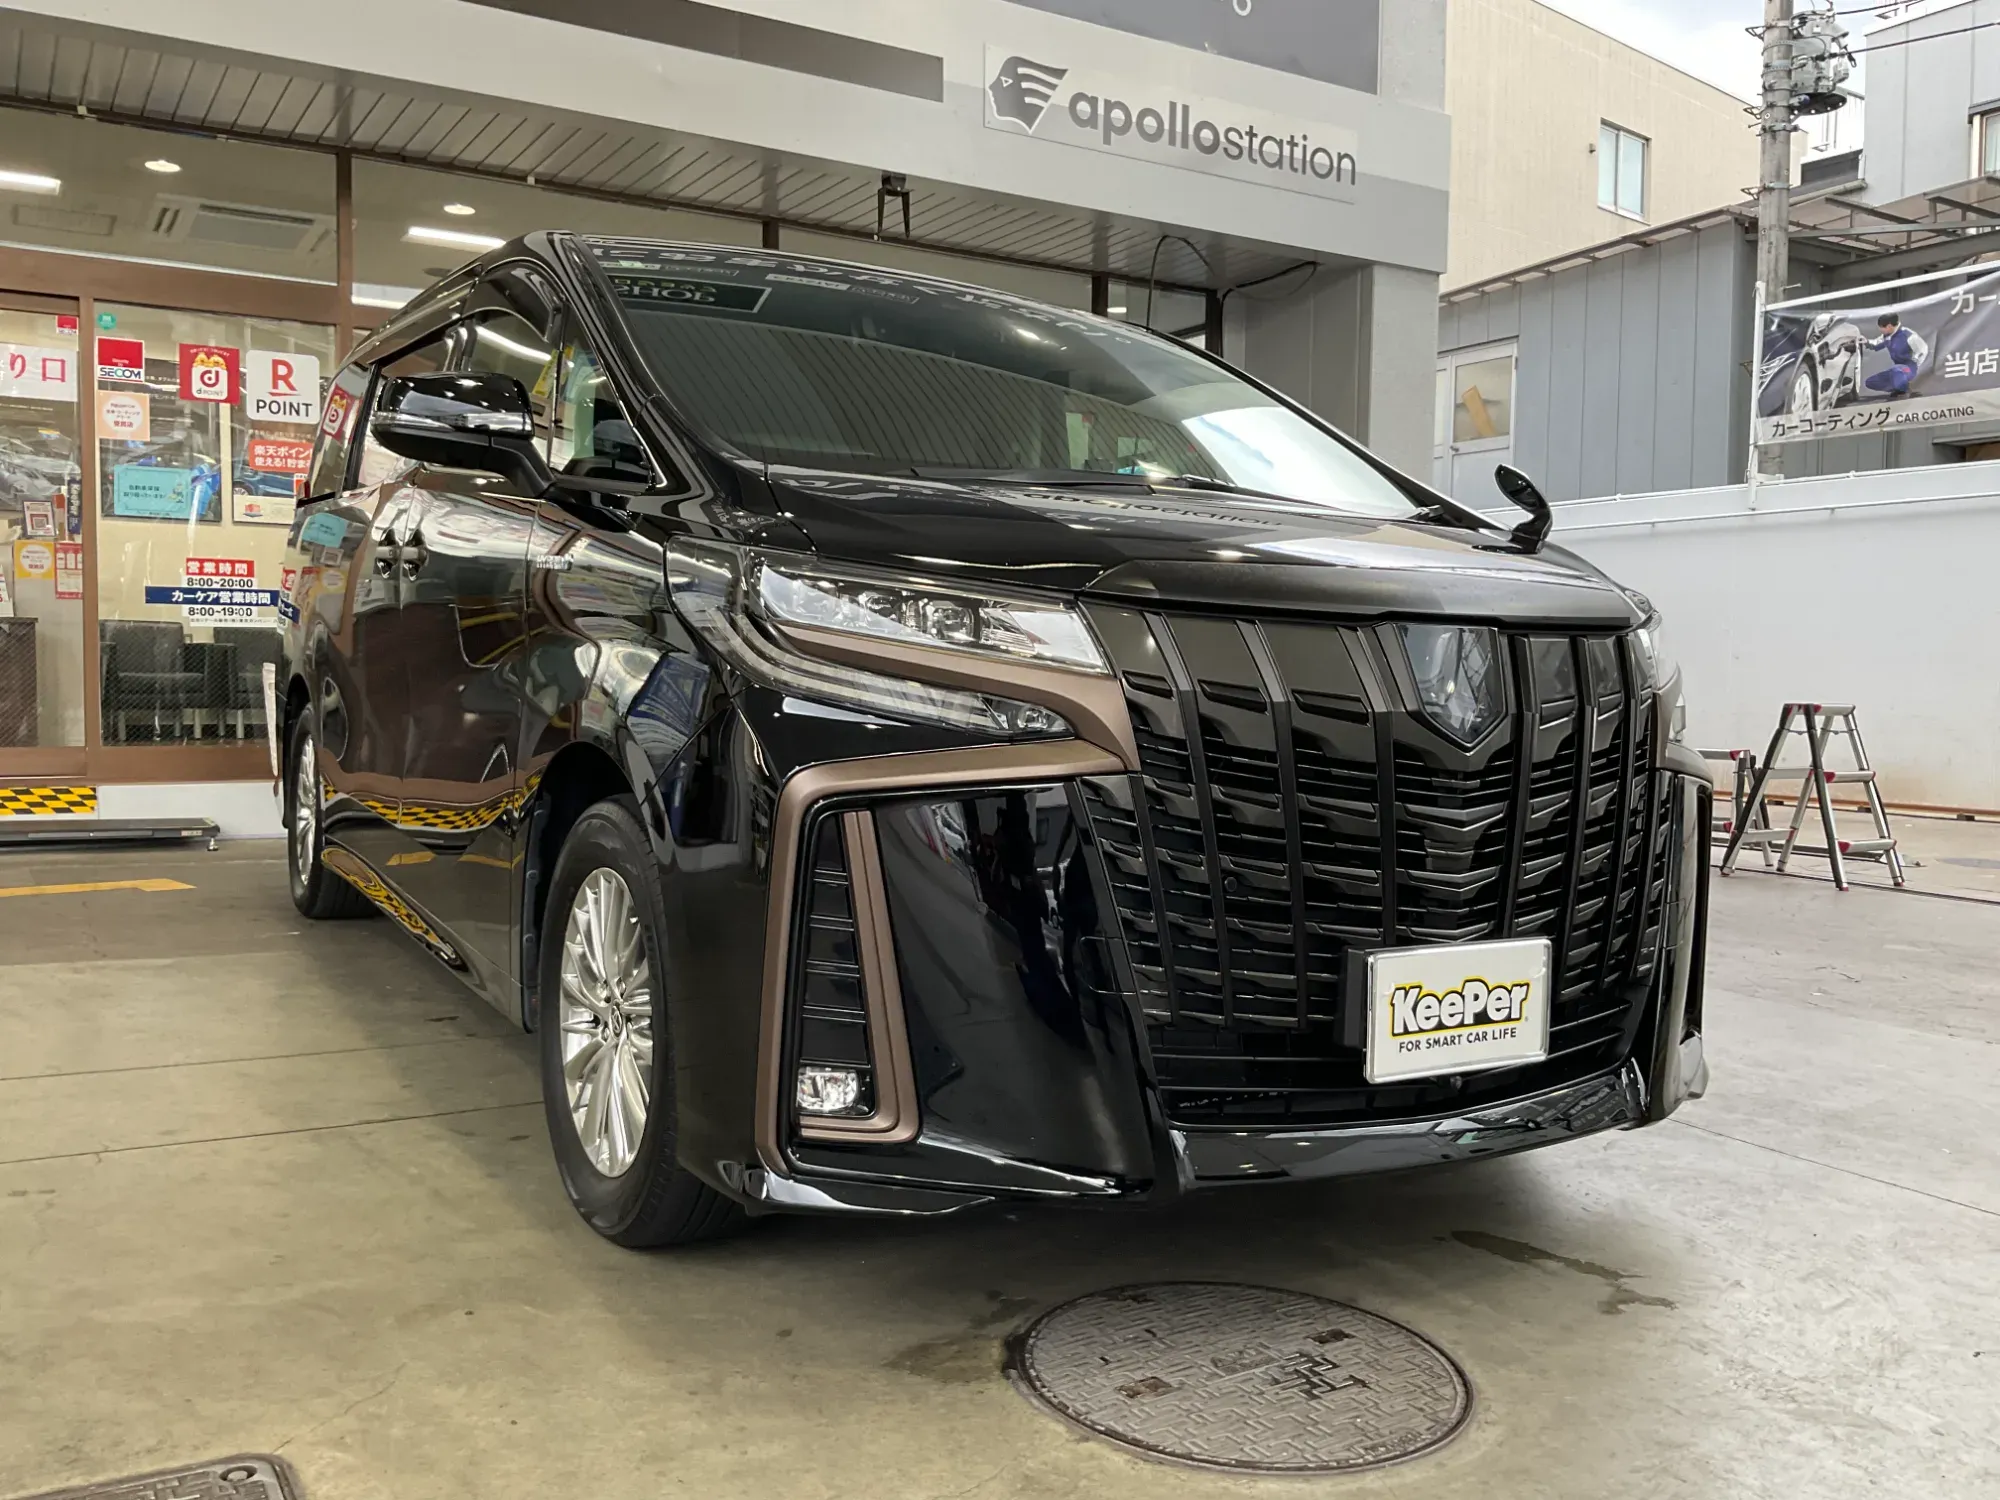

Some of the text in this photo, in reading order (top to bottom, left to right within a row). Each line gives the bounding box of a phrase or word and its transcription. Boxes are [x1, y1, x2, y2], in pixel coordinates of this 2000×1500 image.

[1068, 91, 1356, 186] apollostation
[1950, 290, 2000, 315] カー
[10, 352, 66, 382] り口
[100, 367, 142, 380] SECOM
[1944, 348, 1999, 378] 当店
[256, 399, 313, 418] POINT
[1772, 406, 1975, 437] カーコーティング CAR COATING
[187, 561, 249, 575] 営業時間
[187, 577, 253, 588] 8:00~20:00
[172, 590, 271, 604] カーケア営業時間
[188, 607, 252, 616] 8:00~19:00
[1391, 979, 1529, 1036] KeePer
[1399, 1026, 1517, 1053] FOR SMART CAR LIFE
